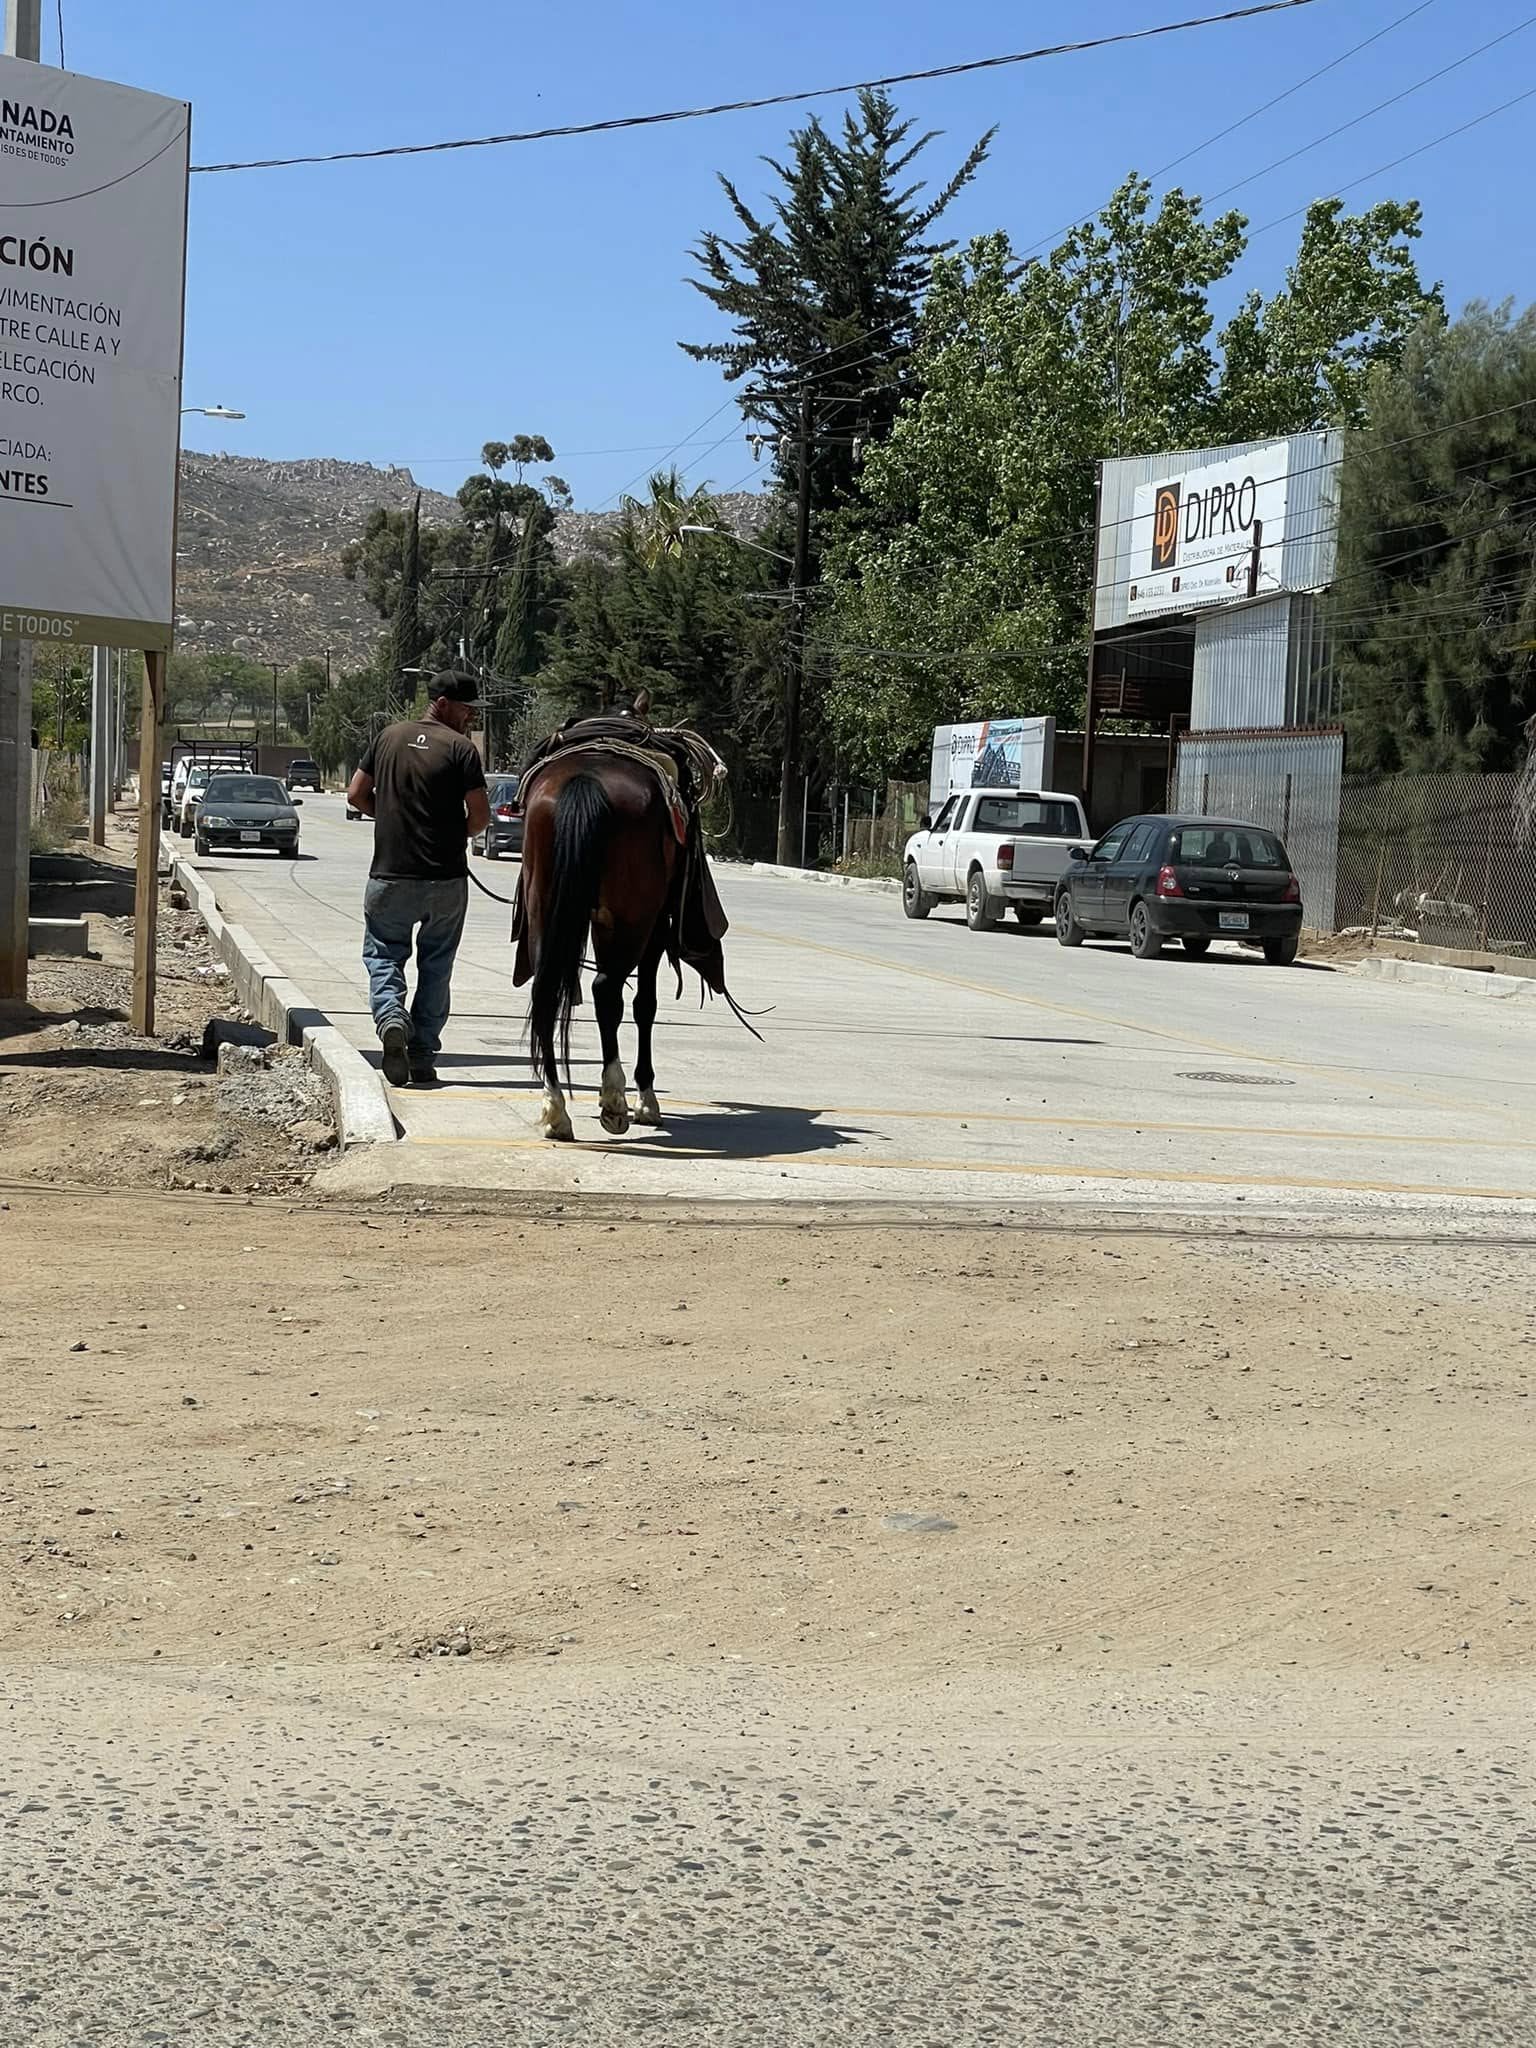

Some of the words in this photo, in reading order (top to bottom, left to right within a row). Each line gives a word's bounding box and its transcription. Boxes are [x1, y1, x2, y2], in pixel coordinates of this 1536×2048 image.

[3, 99, 74, 139] NADA
[0, 126, 74, 155] NTAMIENTO
[16, 147, 26, 158] ES
[28, 150, 39, 161] DE
[0, 235, 73, 276] CIÓN
[0, 317, 31, 340] TRE
[35, 325, 89, 351] CALLE
[94, 335, 107, 354] A
[111, 338, 121, 356] Y
[2, 382, 44, 405] RCO.
[1185, 476, 1256, 543] DIPRO
